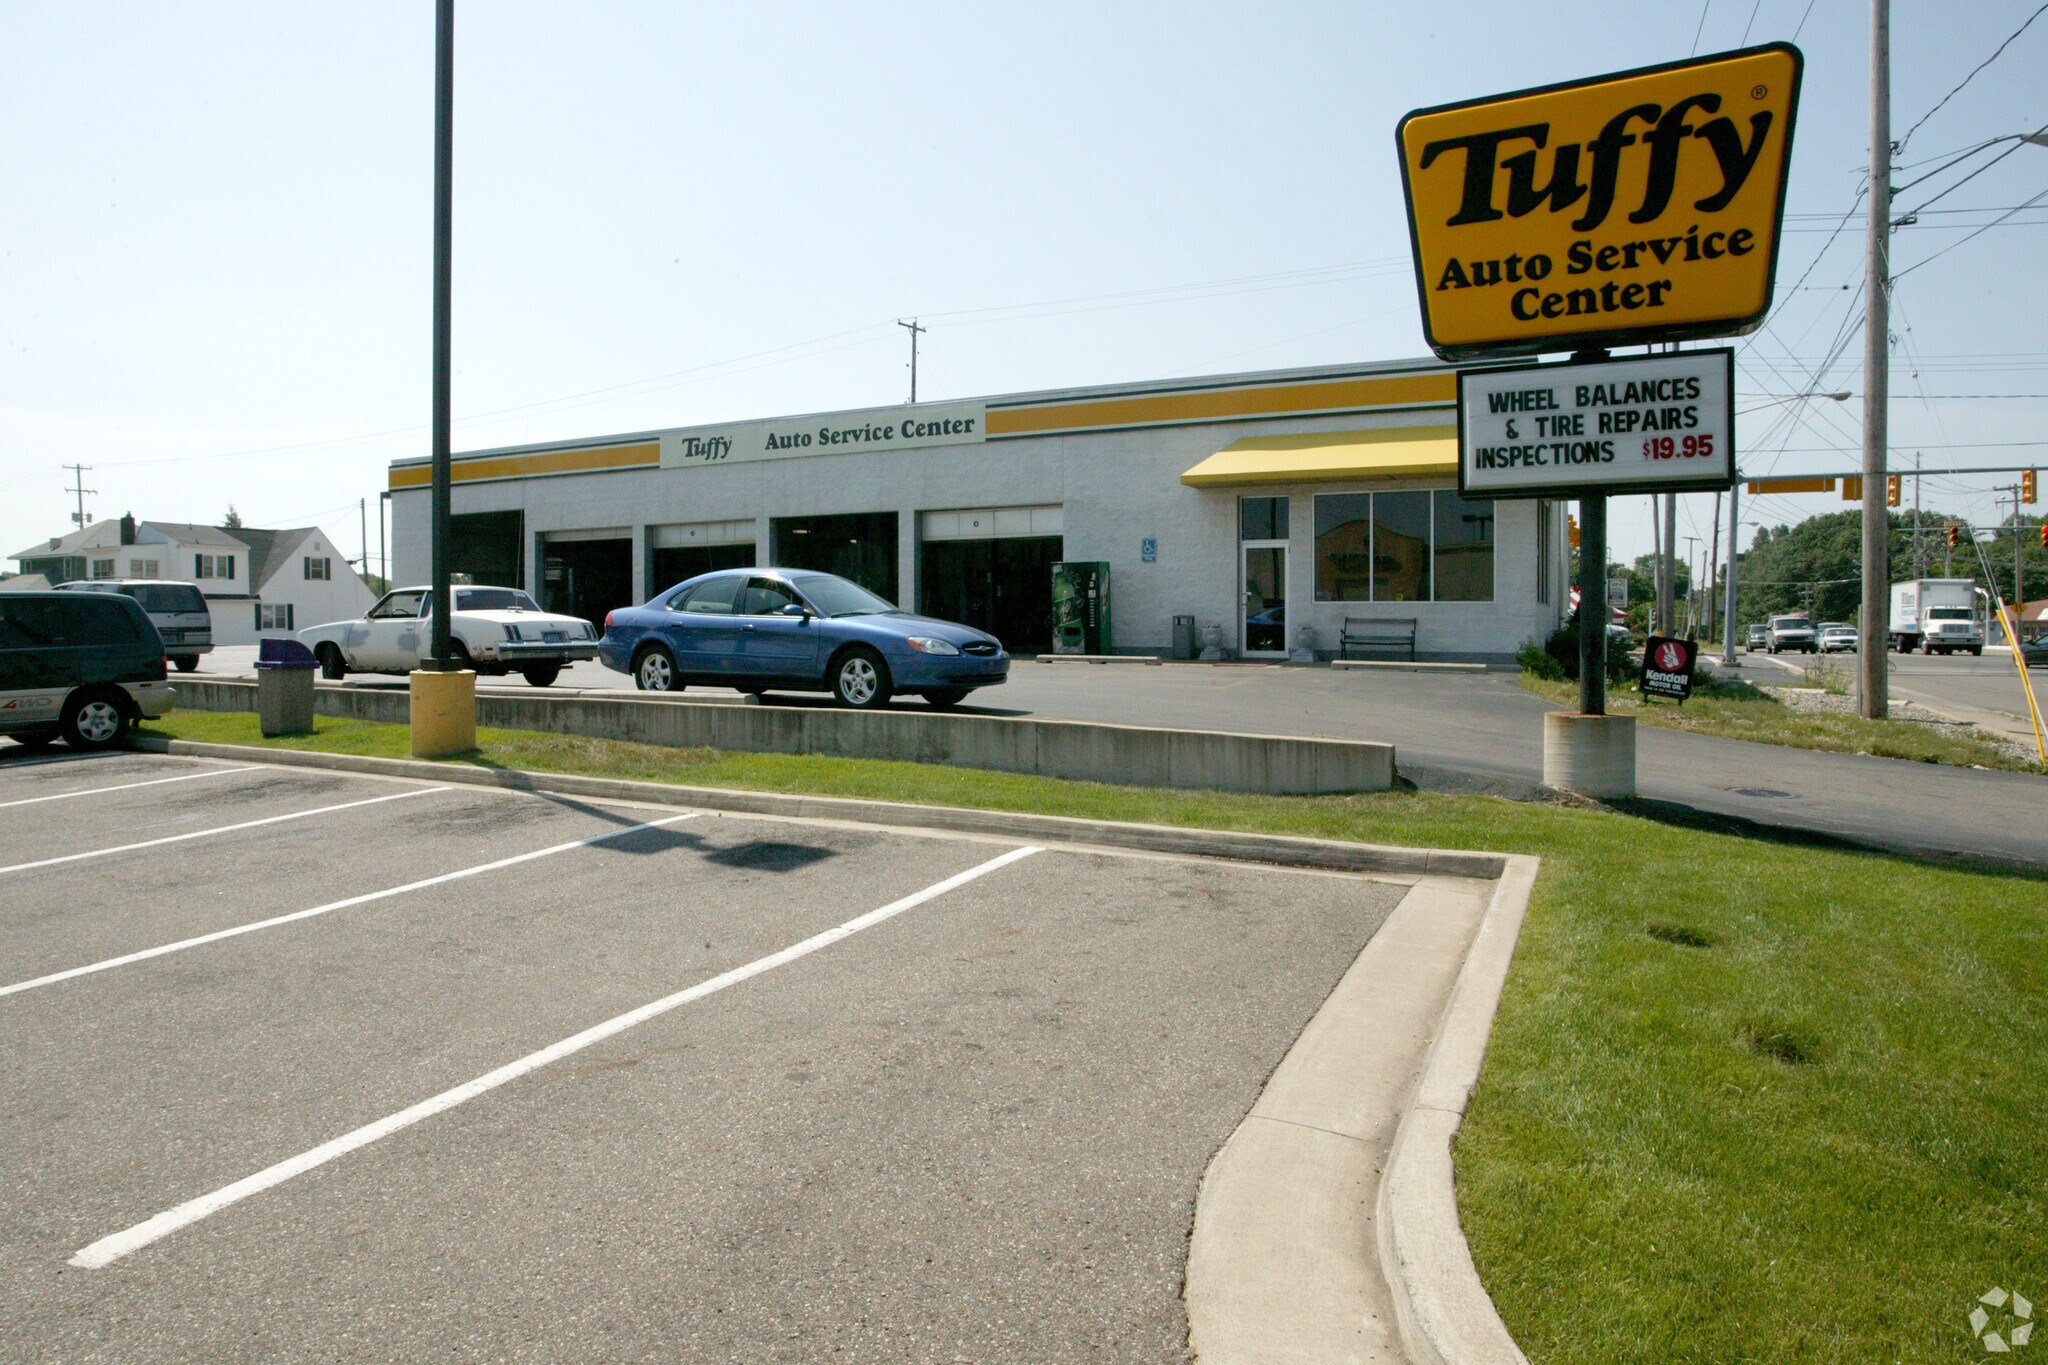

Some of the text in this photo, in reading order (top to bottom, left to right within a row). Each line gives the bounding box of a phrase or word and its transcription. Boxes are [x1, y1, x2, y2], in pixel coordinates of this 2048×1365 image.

[1419, 92, 1773, 232] Tuffy
[1436, 225, 1755, 291] Auto Service
[1511, 279, 1672, 321] Center
[1488, 377, 1700, 413] WHEEL BALANCES
[682, 418, 975, 461] Tuffy Auto Service Center
[1505, 406, 1698, 440] & TIRE REPAIRS
[1475, 434, 1714, 470] INSPECTIONS $19.95
[1645, 669, 1688, 685] Kendall
[1649, 680, 1671, 689] MOTOR
[1672, 683, 1682, 691] OIL
